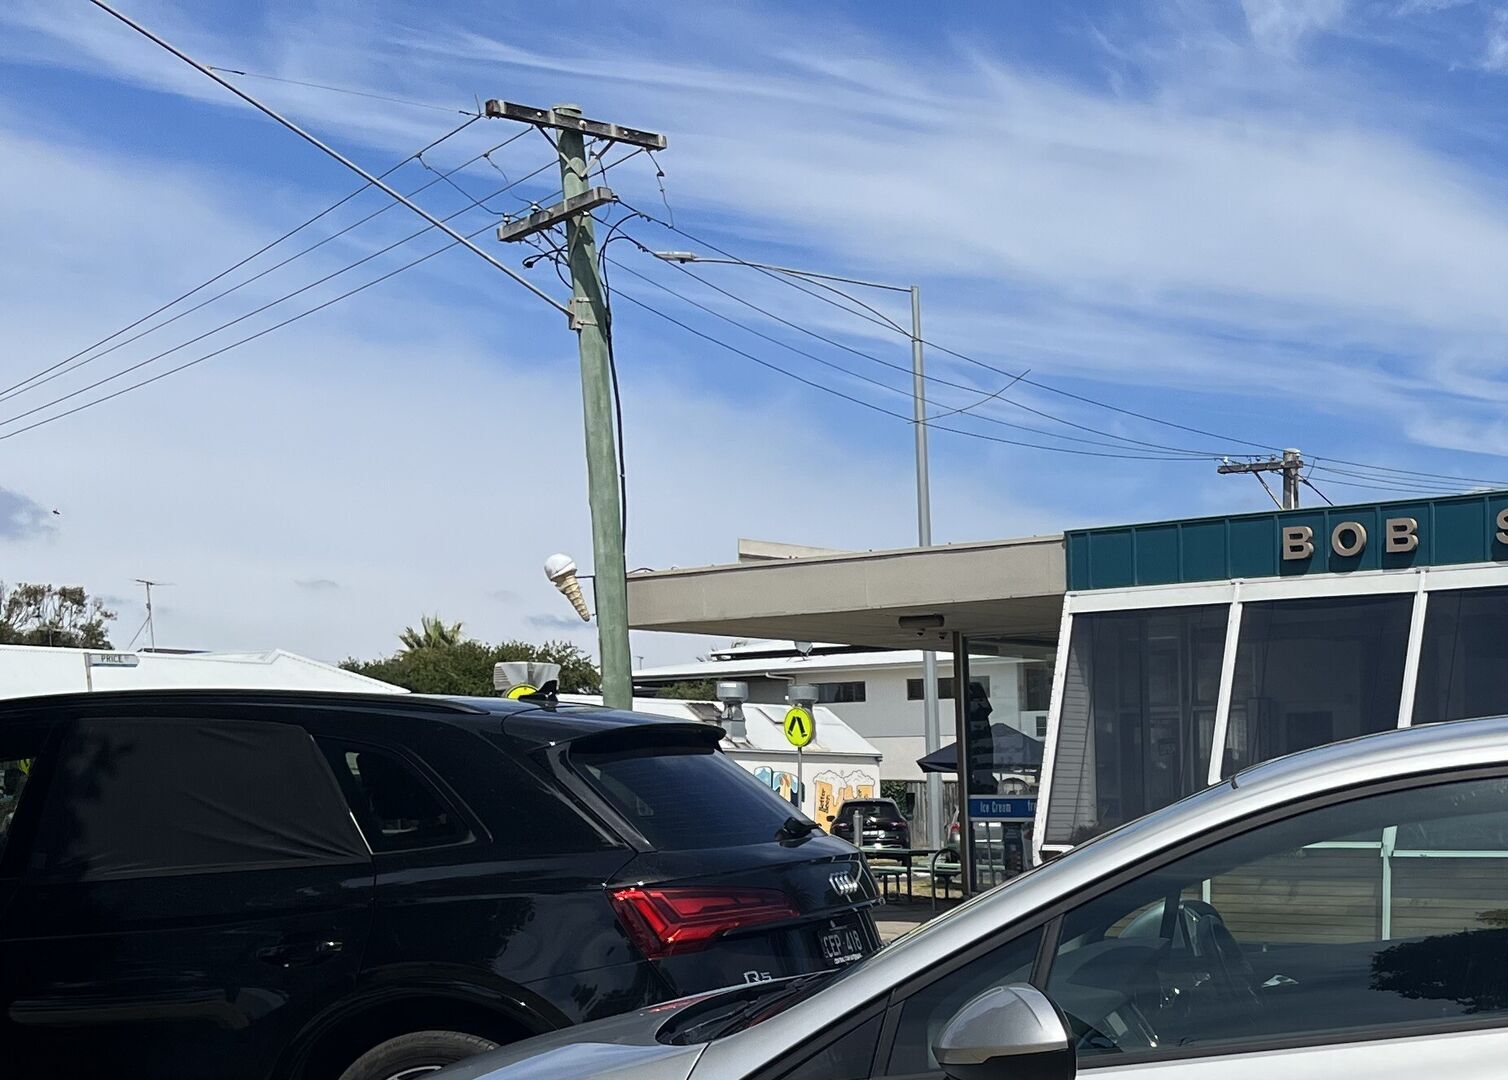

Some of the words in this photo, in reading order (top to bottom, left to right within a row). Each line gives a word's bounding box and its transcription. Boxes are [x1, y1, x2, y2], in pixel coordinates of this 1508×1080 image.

[1283, 518, 1418, 560] BOB
[101, 655, 123, 663] PRICE
[980, 801, 989, 813] Ice
[992, 801, 1012, 813] Cream
